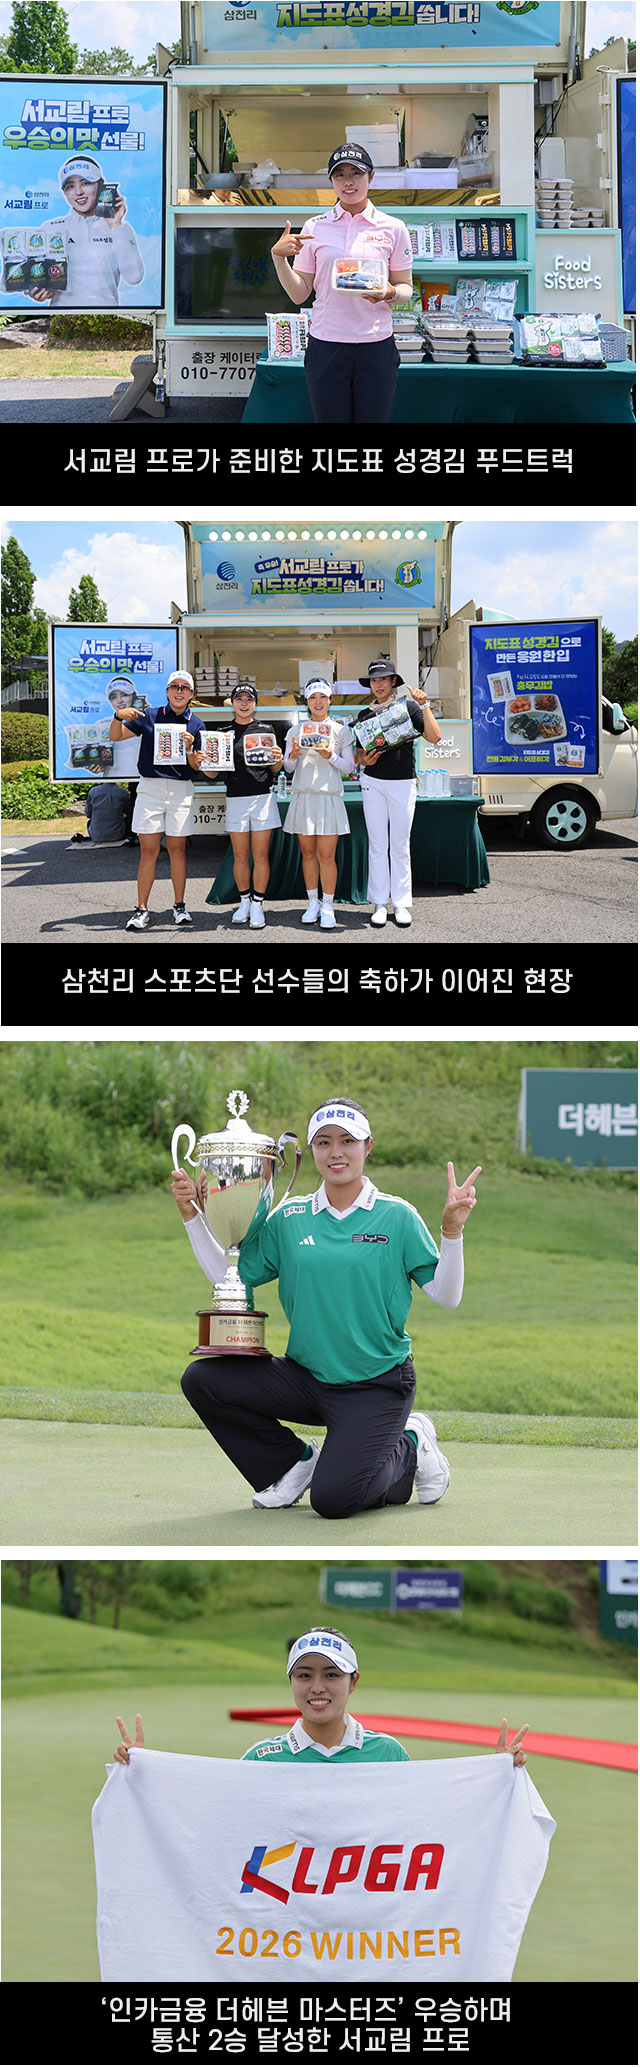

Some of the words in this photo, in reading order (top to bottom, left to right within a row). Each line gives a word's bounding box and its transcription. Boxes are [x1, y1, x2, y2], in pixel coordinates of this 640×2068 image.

[223, 9, 257, 21] 삼천리
[21, 99, 91, 124] 서교림
[92, 105, 130, 124] 프로
[101, 131, 145, 151] 선물!
[4, 200, 33, 210] 서교림
[33, 202, 49, 210] 프로
[553, 255, 592, 273] Food
[543, 271, 603, 290] Sisters
[191, 352, 216, 365] 출장
[180, 367, 256, 380] 010-7707
[279, 558, 325, 575] 서교림
[326, 560, 365, 575] 프로가
[215, 582, 239, 591] 삼천리
[80, 639, 126, 655] 서교림
[127, 643, 153, 655] 프로
[484, 637, 521, 650] 지도표
[496, 653, 517, 664] 만든
[517, 651, 542, 663] 응원
[134, 660, 164, 673] 선물!
[424, 746, 461, 759] Sisters
[198, 805, 215, 813] 출장
[325, 1108, 356, 1121] 삼천리
[558, 1103, 638, 1137] 더헤븐
[352, 1233, 389, 1244] BYD
[226, 1335, 260, 1344] CHAMPION
[308, 1636, 342, 1652] 삼천리
[240, 1840, 444, 1905] KLPGA
[215, 1927, 302, 1958] 2026
[309, 1928, 462, 1961] WINNER
